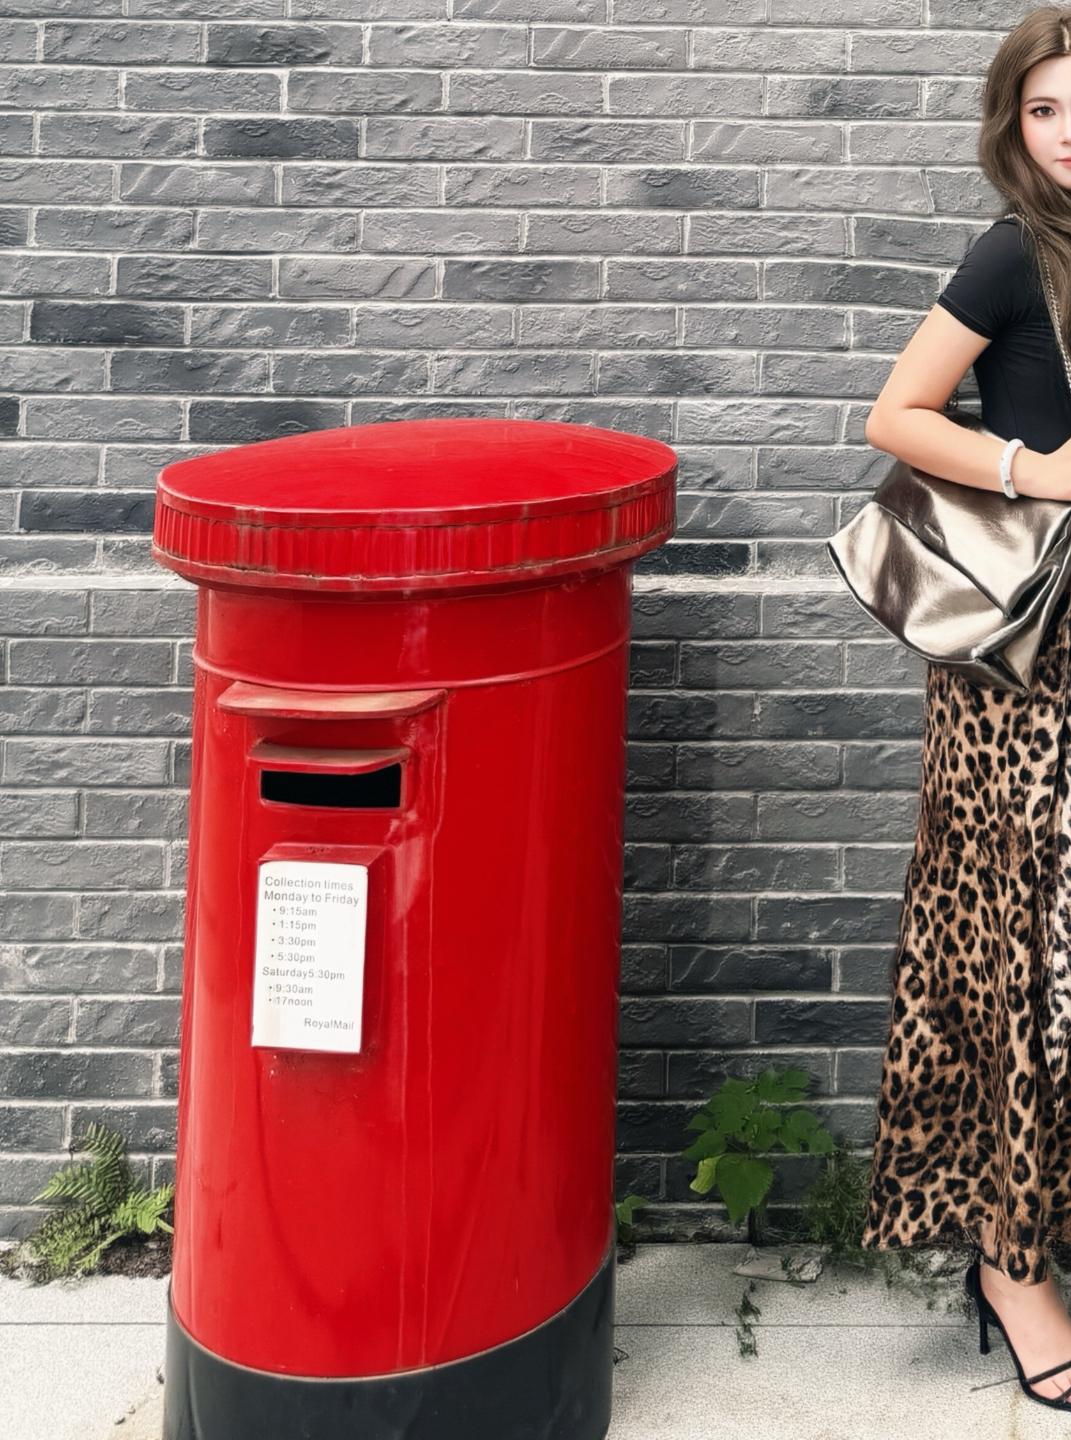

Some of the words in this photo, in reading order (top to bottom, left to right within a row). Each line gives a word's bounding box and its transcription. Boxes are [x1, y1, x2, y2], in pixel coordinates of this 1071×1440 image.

[265, 876, 321, 889] Collection
[324, 880, 354, 891] times
[264, 890, 308, 904] Monday
[311, 894, 322, 902] to
[324, 893, 359, 907] Friday
[279, 906, 317, 916] 9:15am
[280, 920, 316, 931] 1:15pm
[278, 936, 316, 947] 3:30pm
[278, 952, 315, 964] 5:30pm
[276, 984, 313, 994] 9:30am
